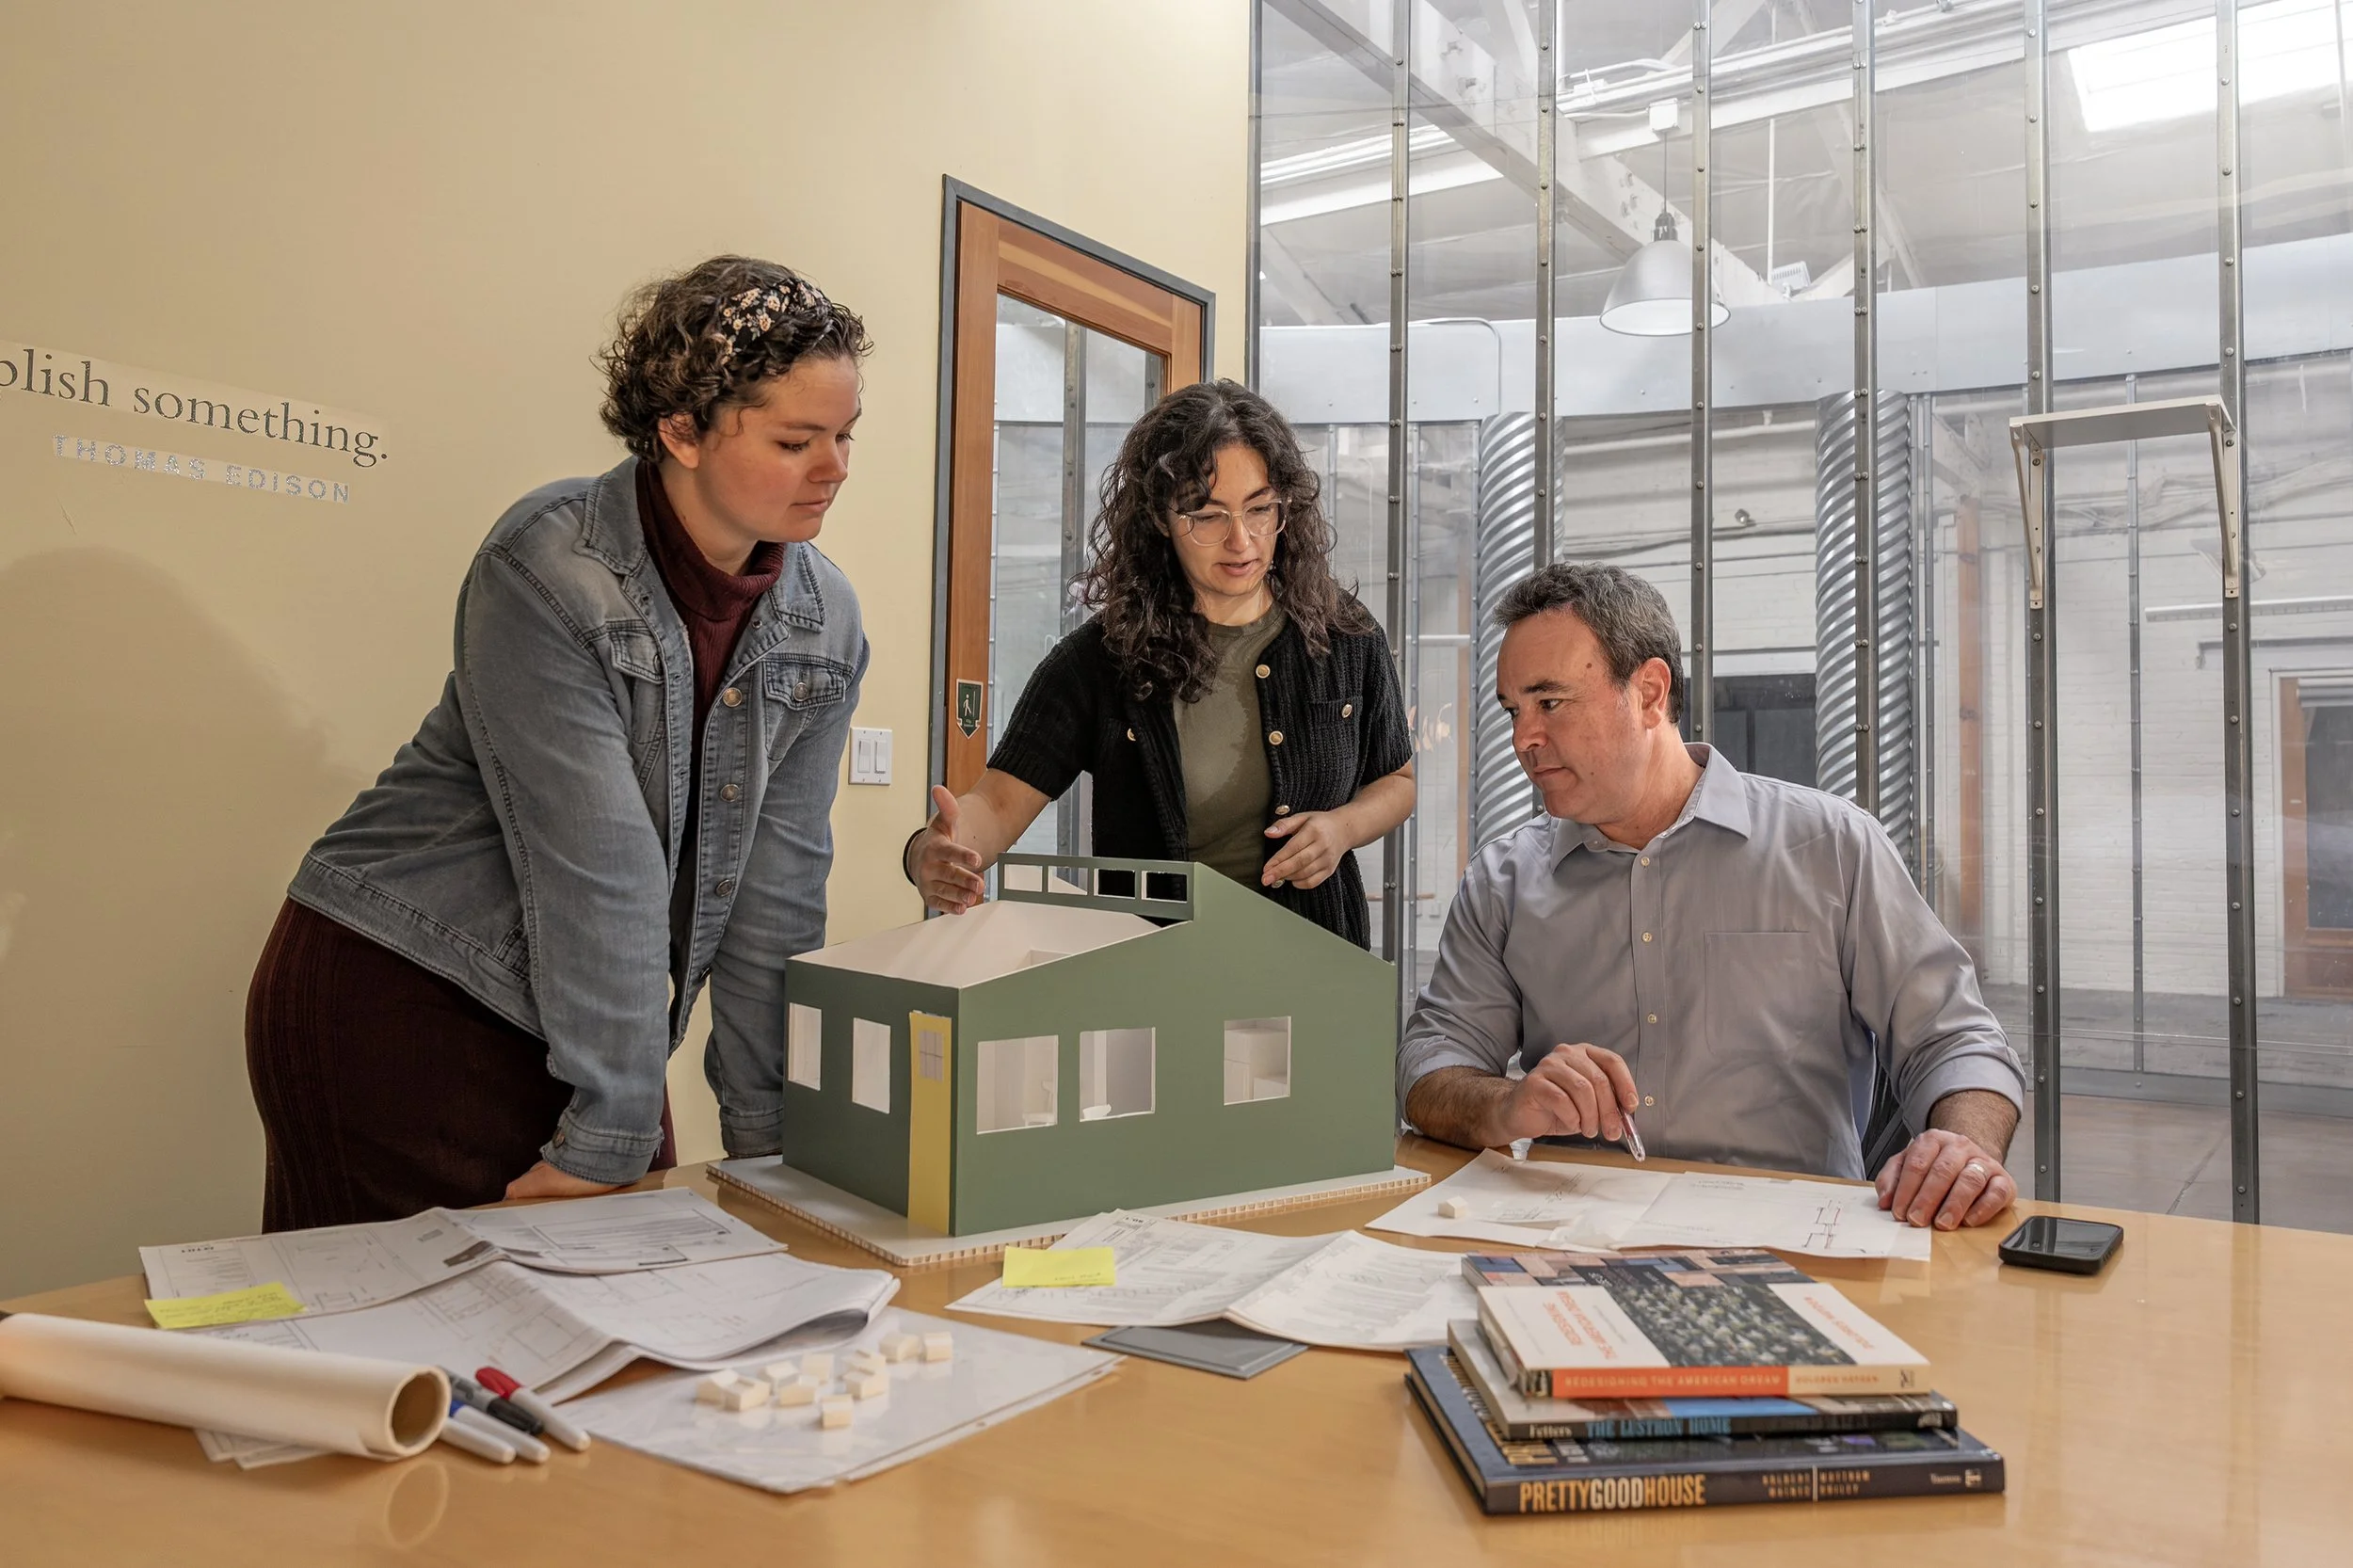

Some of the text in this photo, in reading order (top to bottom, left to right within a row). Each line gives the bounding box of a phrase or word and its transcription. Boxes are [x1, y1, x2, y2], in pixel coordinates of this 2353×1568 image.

[133, 387, 388, 468] something.
[53, 433, 349, 504] THOMAS EDISON
[1564, 1373, 1782, 1388] REDESIGNING THE AMERICAN DREAM
[1586, 1420, 1615, 1437] THE
[1689, 1416, 1732, 1434] HOME
